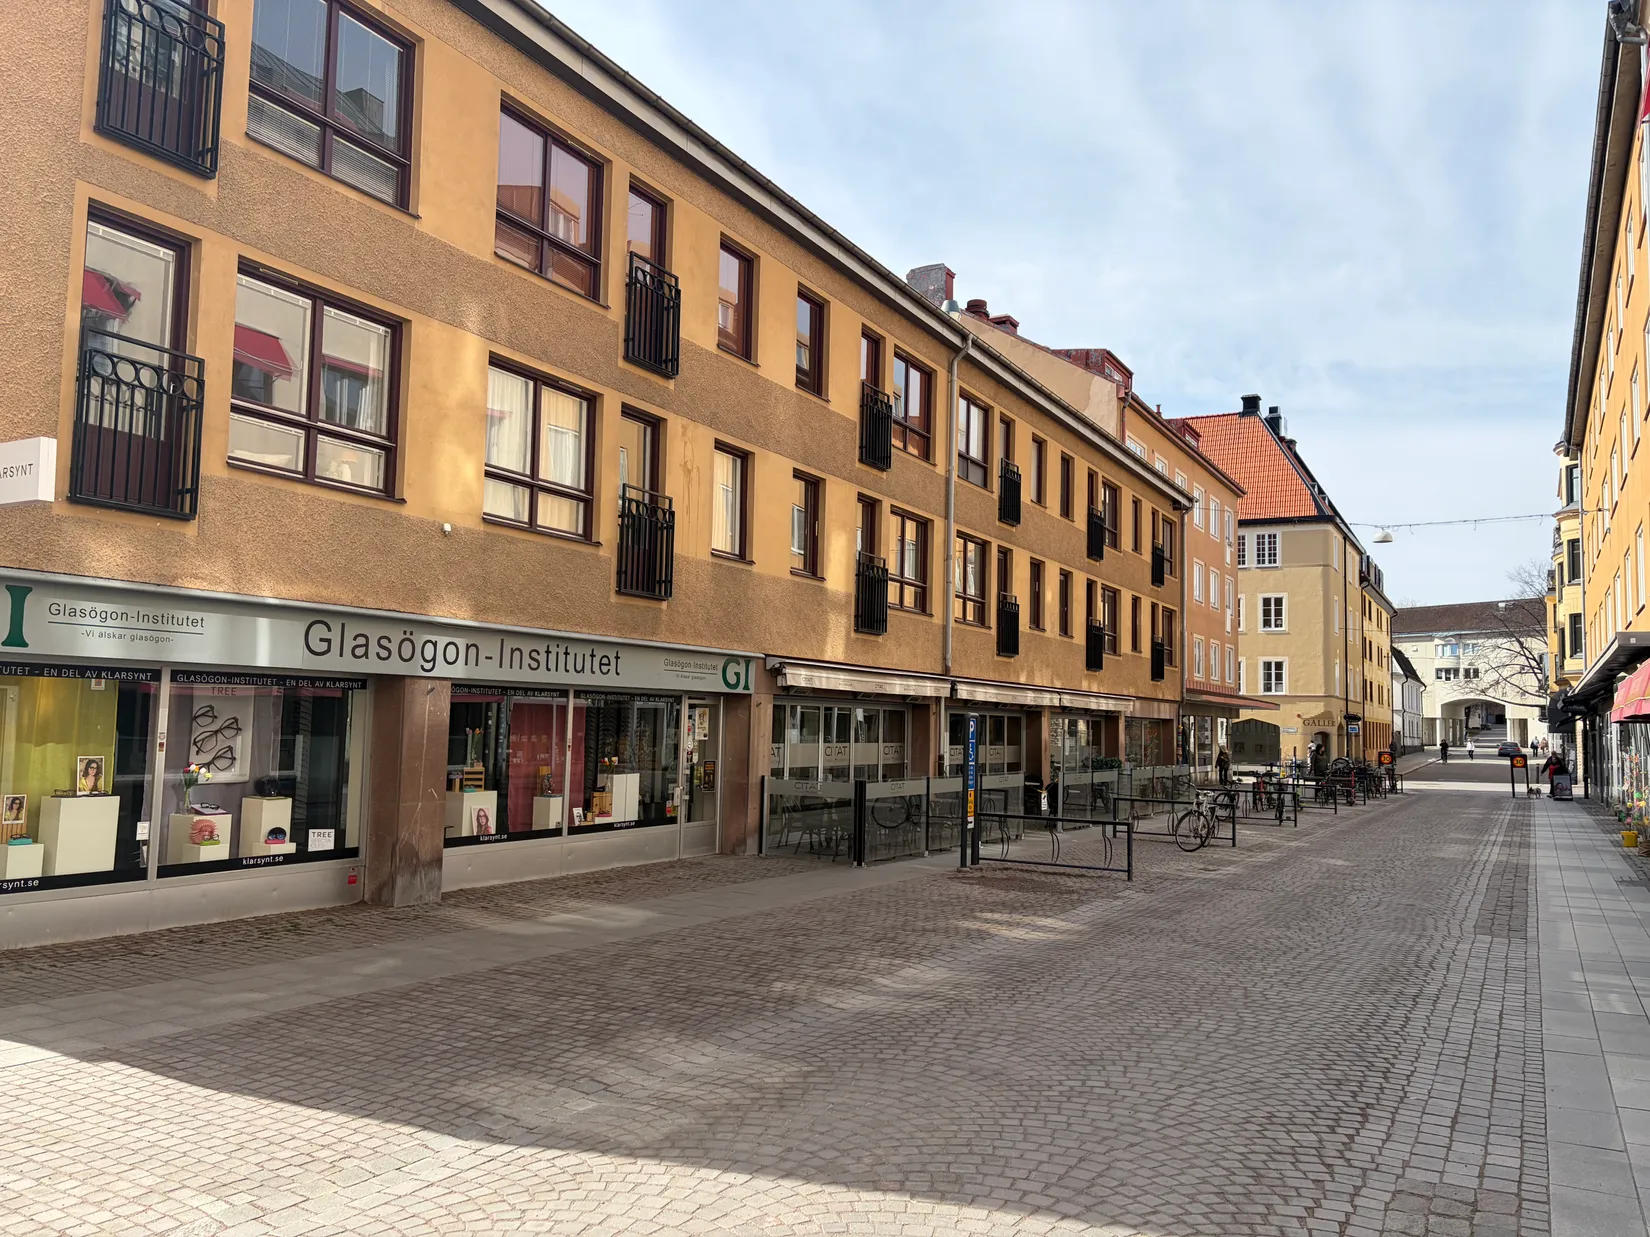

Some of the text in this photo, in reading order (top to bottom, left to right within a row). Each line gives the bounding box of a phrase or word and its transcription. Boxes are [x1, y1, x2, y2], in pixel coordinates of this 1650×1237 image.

[48, 602, 205, 628] Glasögon-Institutet
[303, 619, 621, 676] Glasögon-Institutet
[663, 658, 718, 671] Glasögon-Institutet
[44, 668, 58, 677] EN
[62, 668, 81, 678] DEL
[85, 670, 98, 678] AV
[101, 670, 152, 681] KLARSYNT
[722, 657, 751, 691] GI
[176, 673, 277, 686] GLASÖGON-INSTITUTET
[286, 679, 296, 687] EN
[298, 680, 312, 688] DEL
[315, 680, 324, 688] AV
[326, 680, 362, 689] KLARSYNT
[210, 686, 237, 696] TREE
[824, 746, 848, 756] CITAT
[883, 745, 903, 756] CITAT
[1515, 757, 1523, 765] 30
[794, 781, 822, 790] CITAT
[480, 833, 507, 842] klarsynt.se
[242, 854, 284, 866] klarsynt.se
